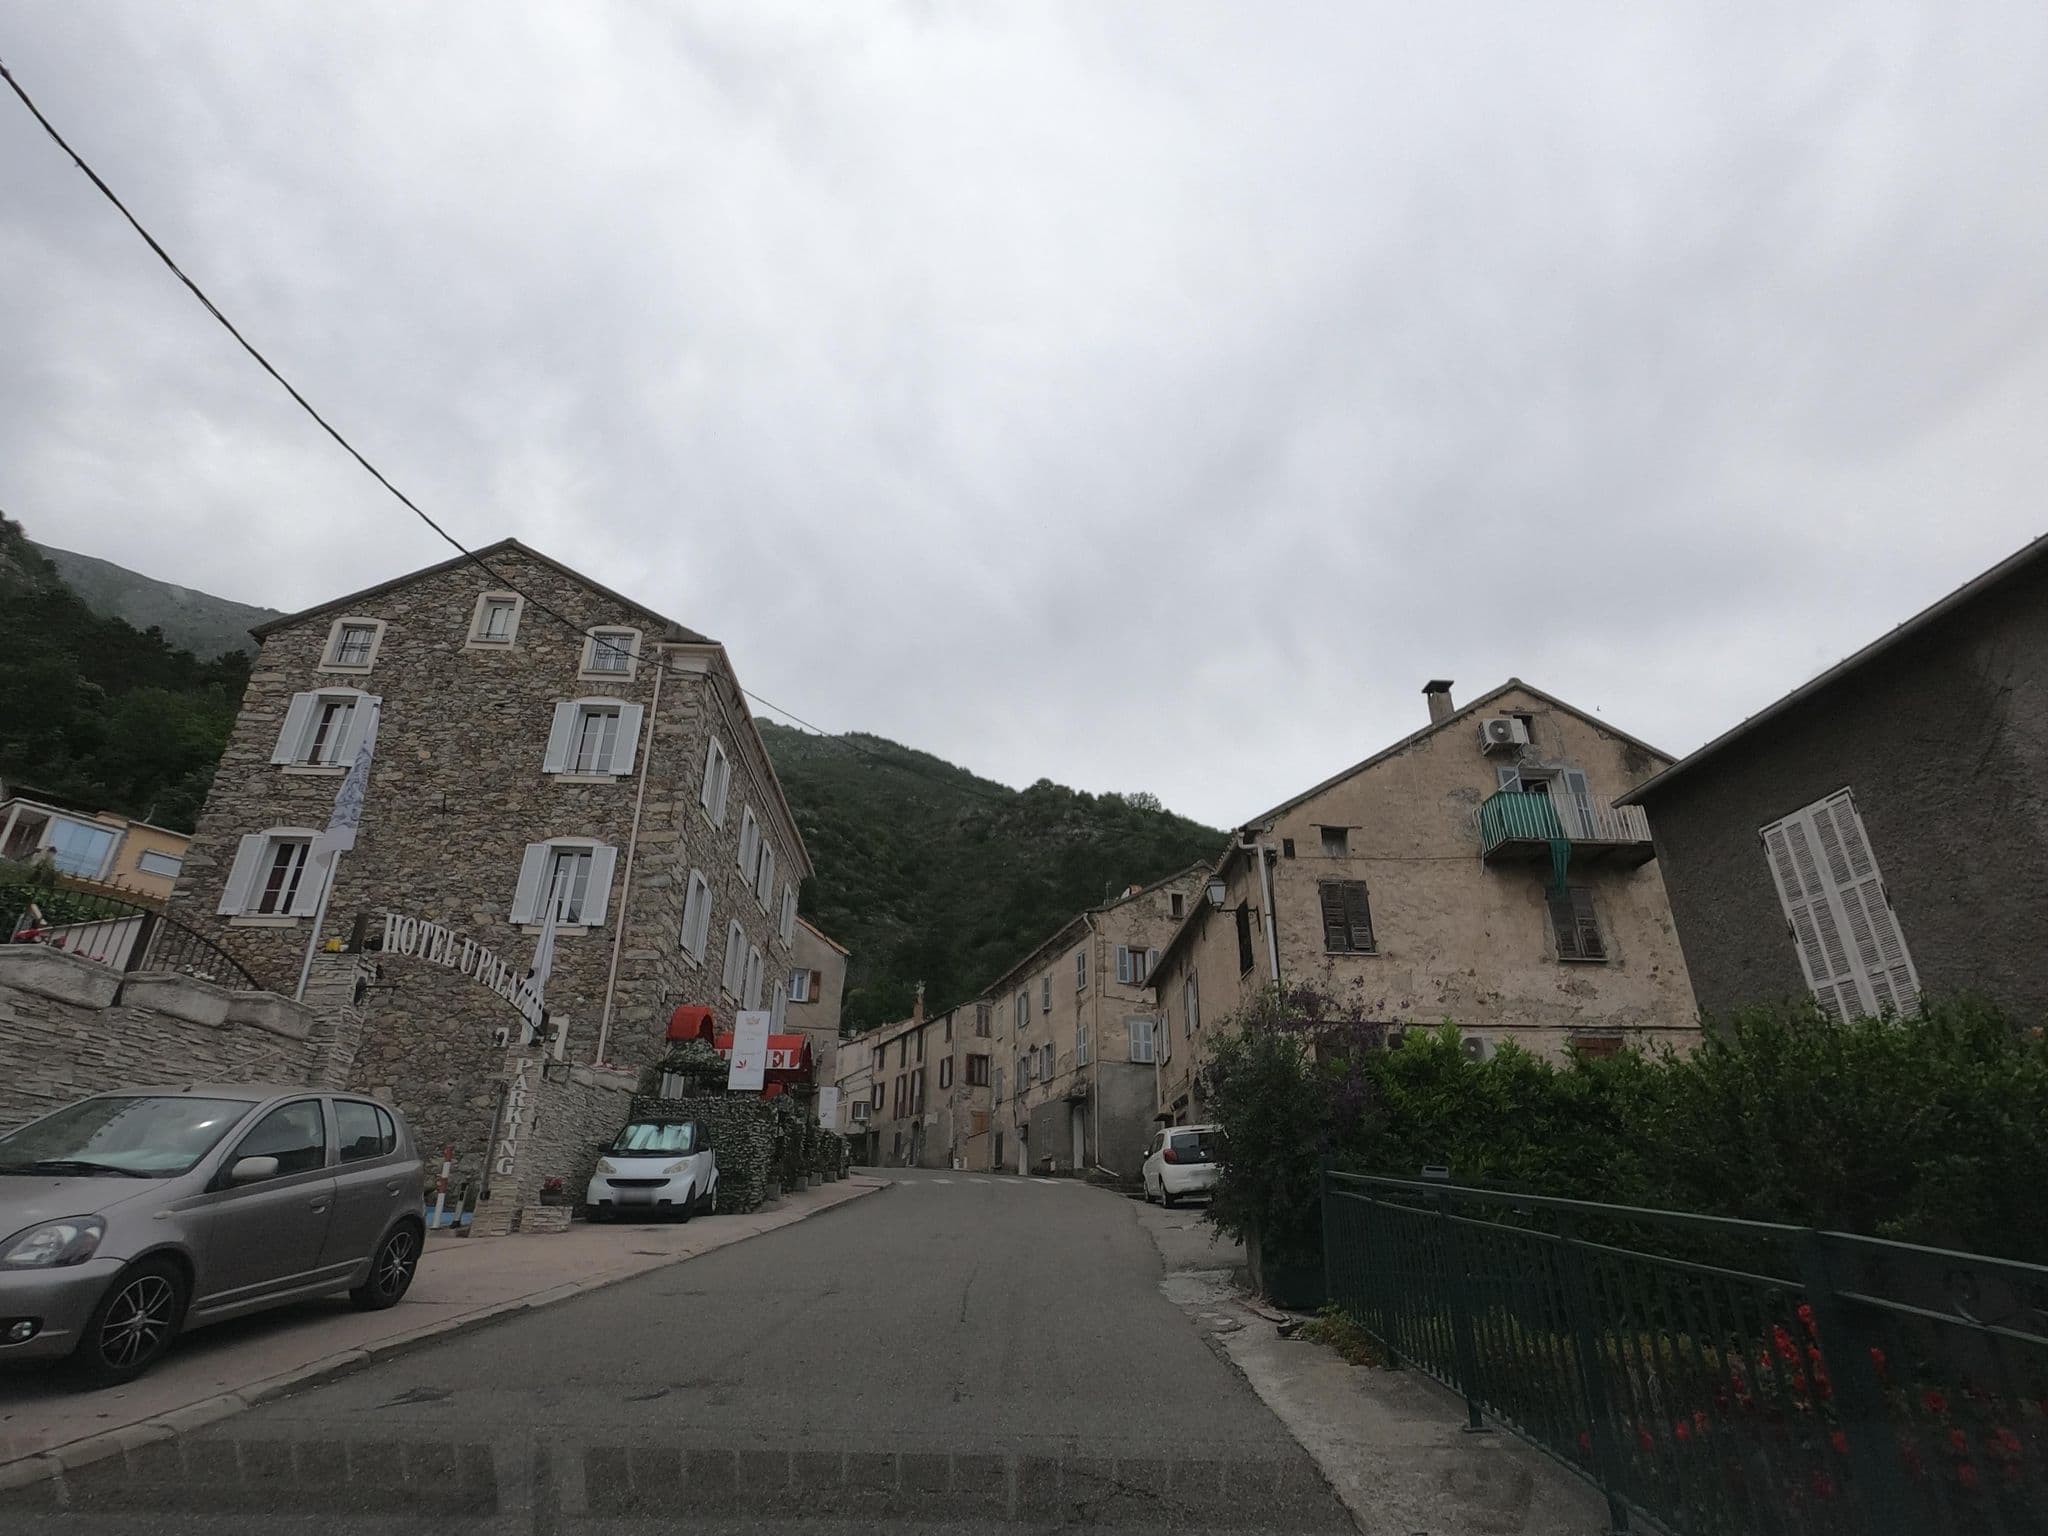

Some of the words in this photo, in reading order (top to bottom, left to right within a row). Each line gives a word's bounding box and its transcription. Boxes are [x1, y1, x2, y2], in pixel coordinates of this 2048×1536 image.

[382, 912, 457, 968] HOTEL
[460, 937, 479, 975] U
[496, 1057, 534, 1175] PARKING
